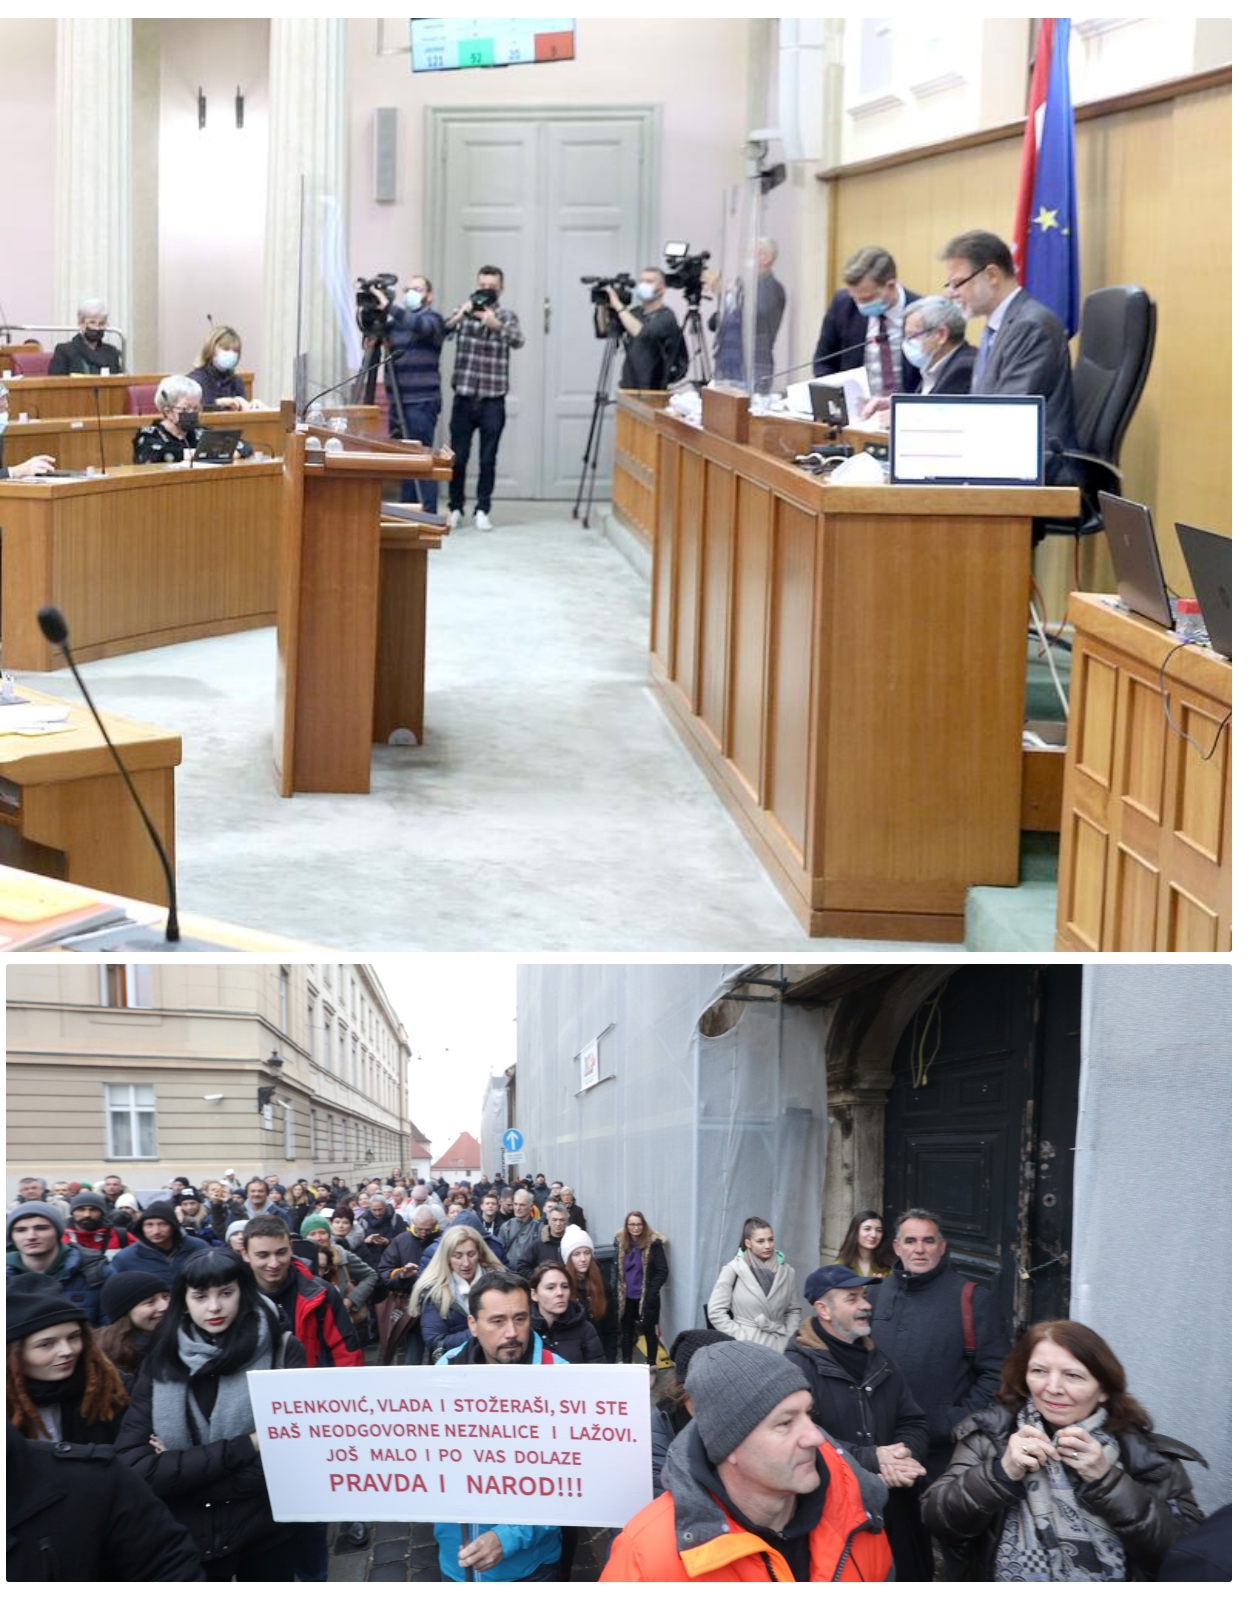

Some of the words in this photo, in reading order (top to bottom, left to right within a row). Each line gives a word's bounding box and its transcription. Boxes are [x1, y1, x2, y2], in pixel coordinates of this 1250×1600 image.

[271, 1395, 375, 1415] PLENKOVIĆ,
[376, 1398, 433, 1412] VLADA
[440, 1399, 445, 1412] I
[454, 1396, 555, 1416] STOŽERAŠI,
[559, 1399, 586, 1414] SVI
[595, 1400, 628, 1416] STE
[267, 1422, 301, 1439] BAŠ
[309, 1423, 440, 1438] NEODGOVORNE
[444, 1423, 540, 1439] NEZNALICE
[552, 1425, 557, 1439] I
[570, 1423, 638, 1443] LAŽOVI.
[326, 1446, 359, 1462] JOŠ
[370, 1448, 417, 1462] MALO
[426, 1448, 430, 1462] I
[438, 1448, 462, 1462] PO
[473, 1449, 506, 1463] VAS
[514, 1450, 582, 1466] DOLAZE
[329, 1473, 428, 1493] PRAVDA
[439, 1474, 446, 1493] I
[466, 1474, 583, 1498] NAROD!!!
